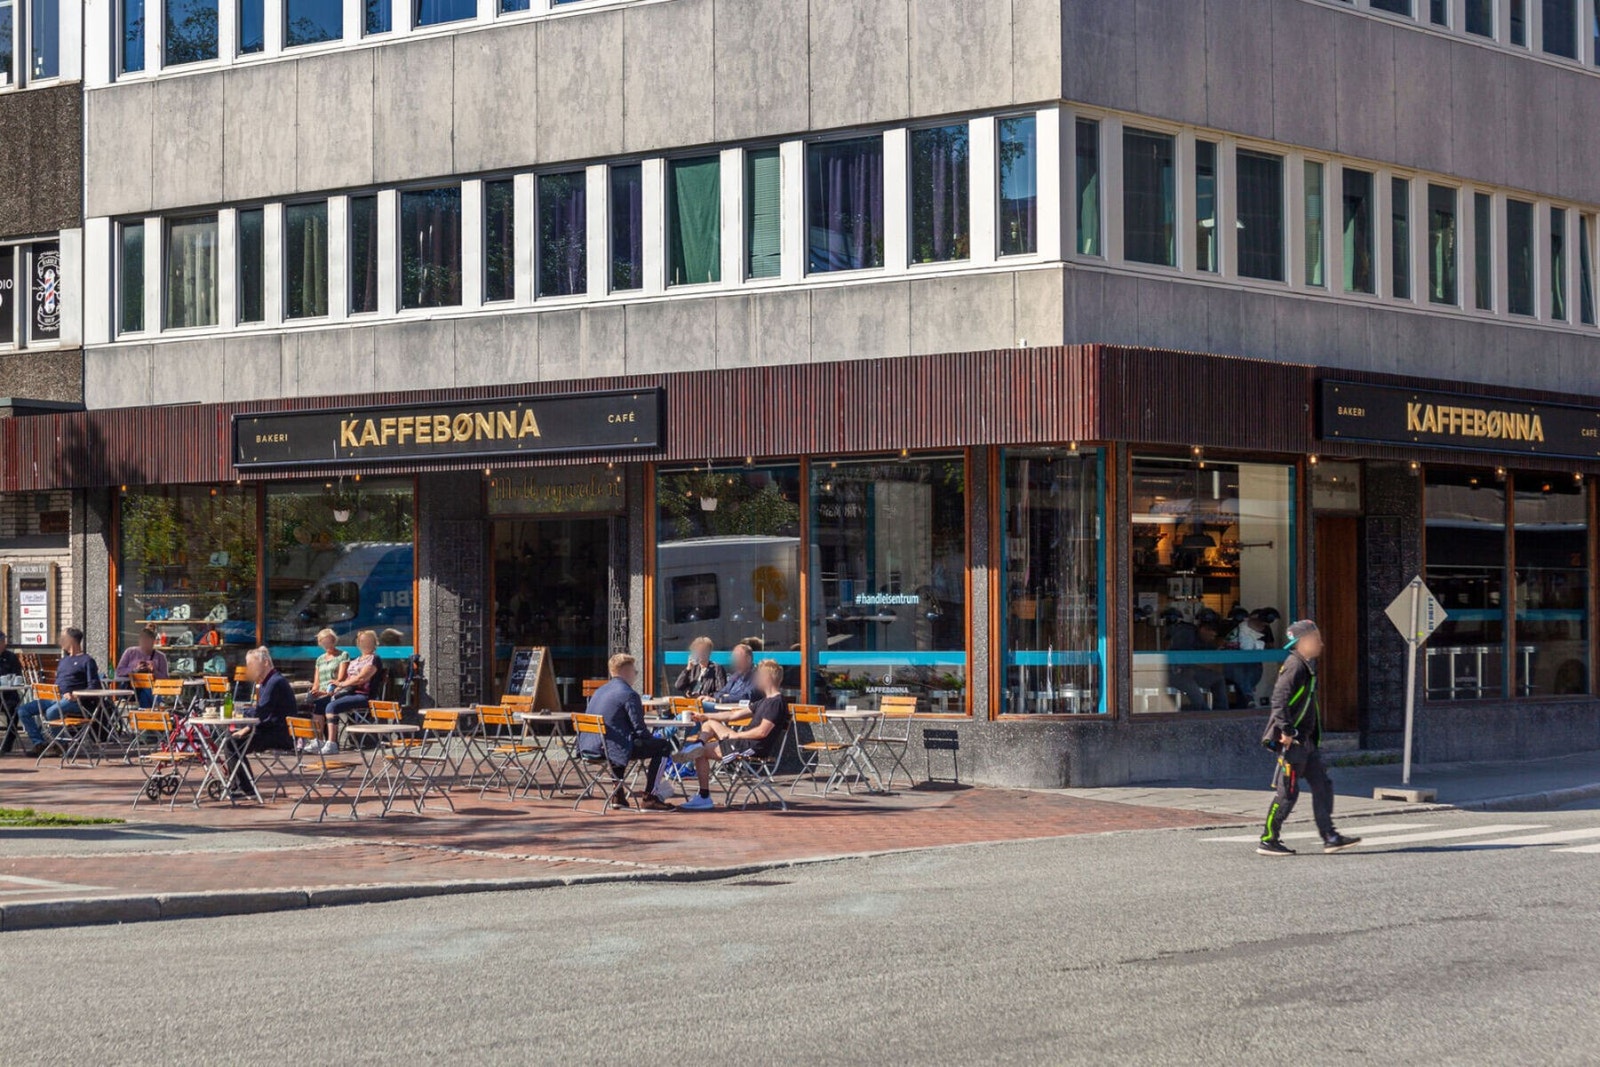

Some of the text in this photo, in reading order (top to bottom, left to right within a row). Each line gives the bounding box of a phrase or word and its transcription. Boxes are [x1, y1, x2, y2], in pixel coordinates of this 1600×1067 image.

[256, 408, 635, 448] BAKERI KAFFEBØNNA CAFÉ
[1338, 406, 1365, 417] BAKERI
[1407, 402, 1544, 442] KAFFEBØNNA
[855, 592, 919, 605] #handleisentrum
